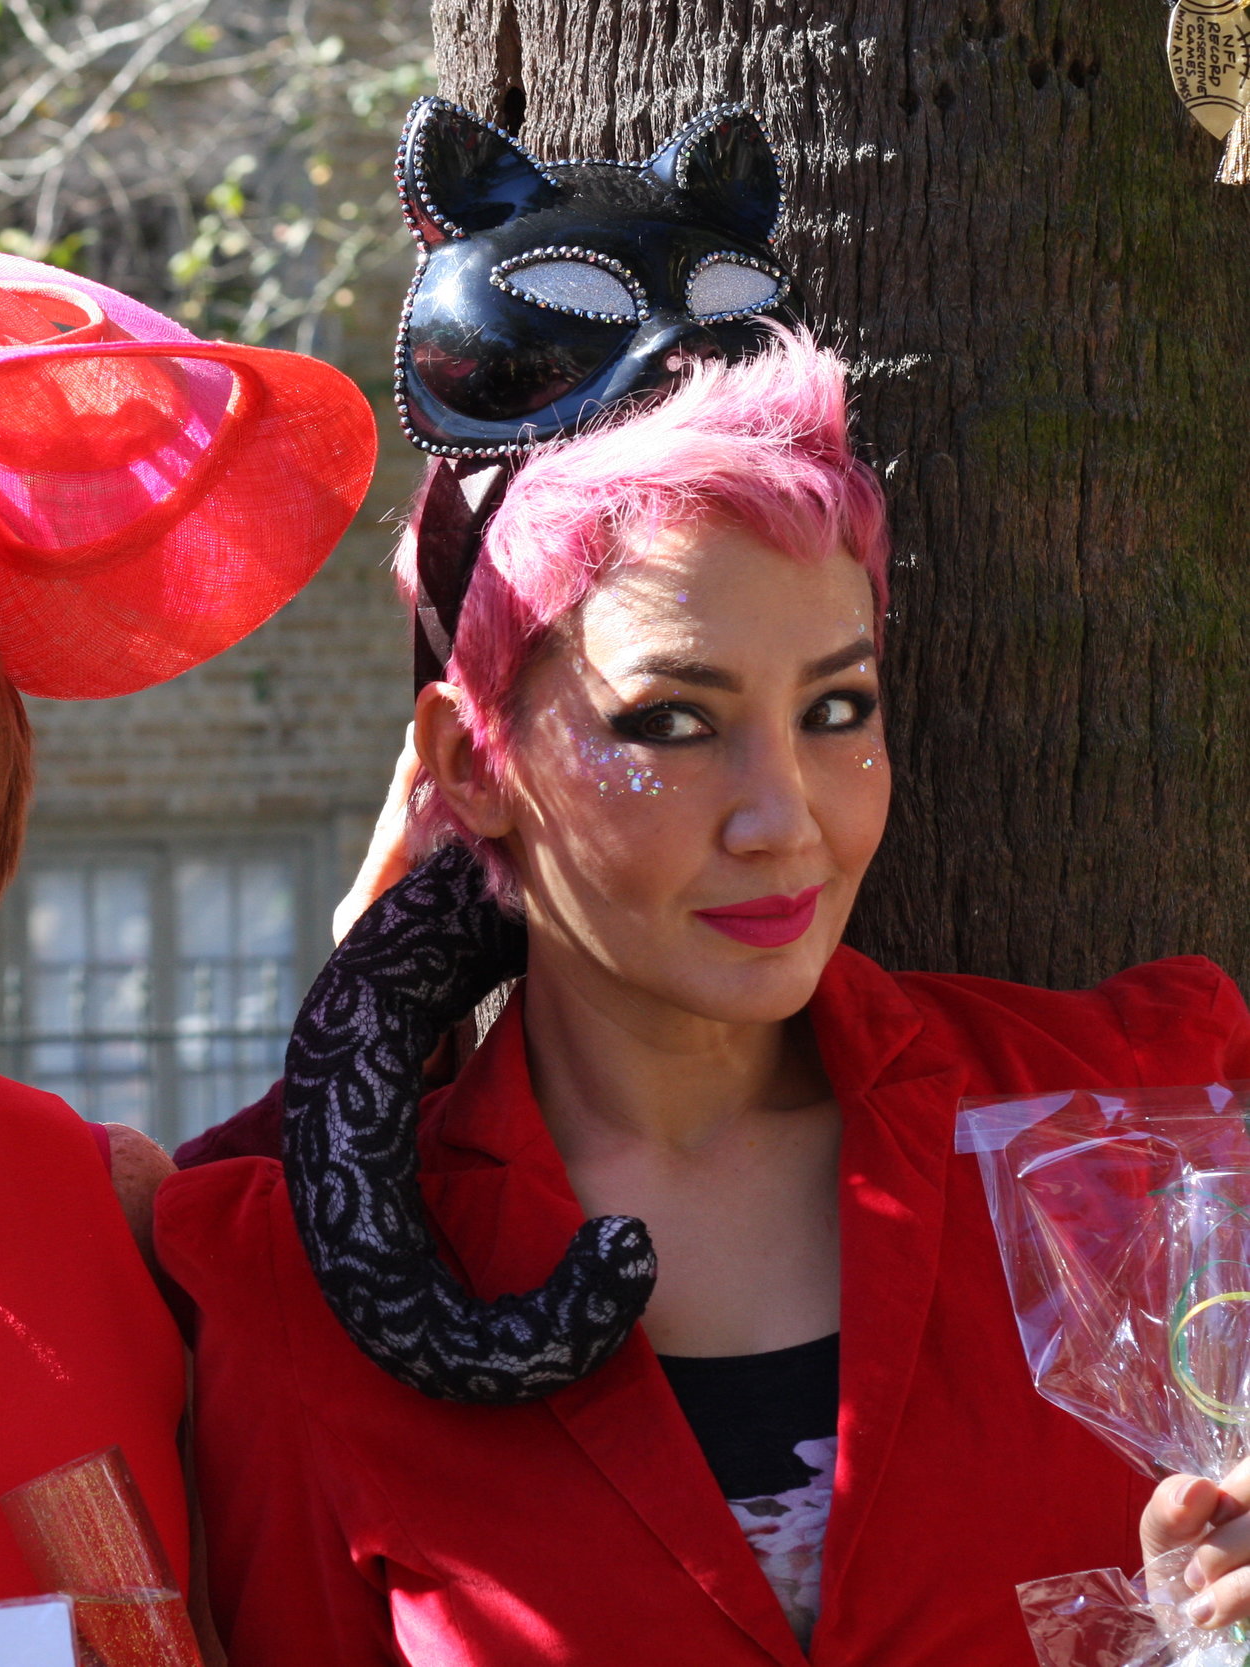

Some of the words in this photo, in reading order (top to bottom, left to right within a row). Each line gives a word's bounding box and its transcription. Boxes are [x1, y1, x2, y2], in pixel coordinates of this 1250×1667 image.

[1173, 9, 1186, 41] WITH
[1172, 44, 1183, 56] A
[1172, 57, 1184, 75] TD
[1185, 24, 1196, 77] GAMES
[1196, 16, 1207, 96] CONSECUTIVE
[1207, 21, 1221, 87] RECORD
[1222, 34, 1236, 74] NFL
